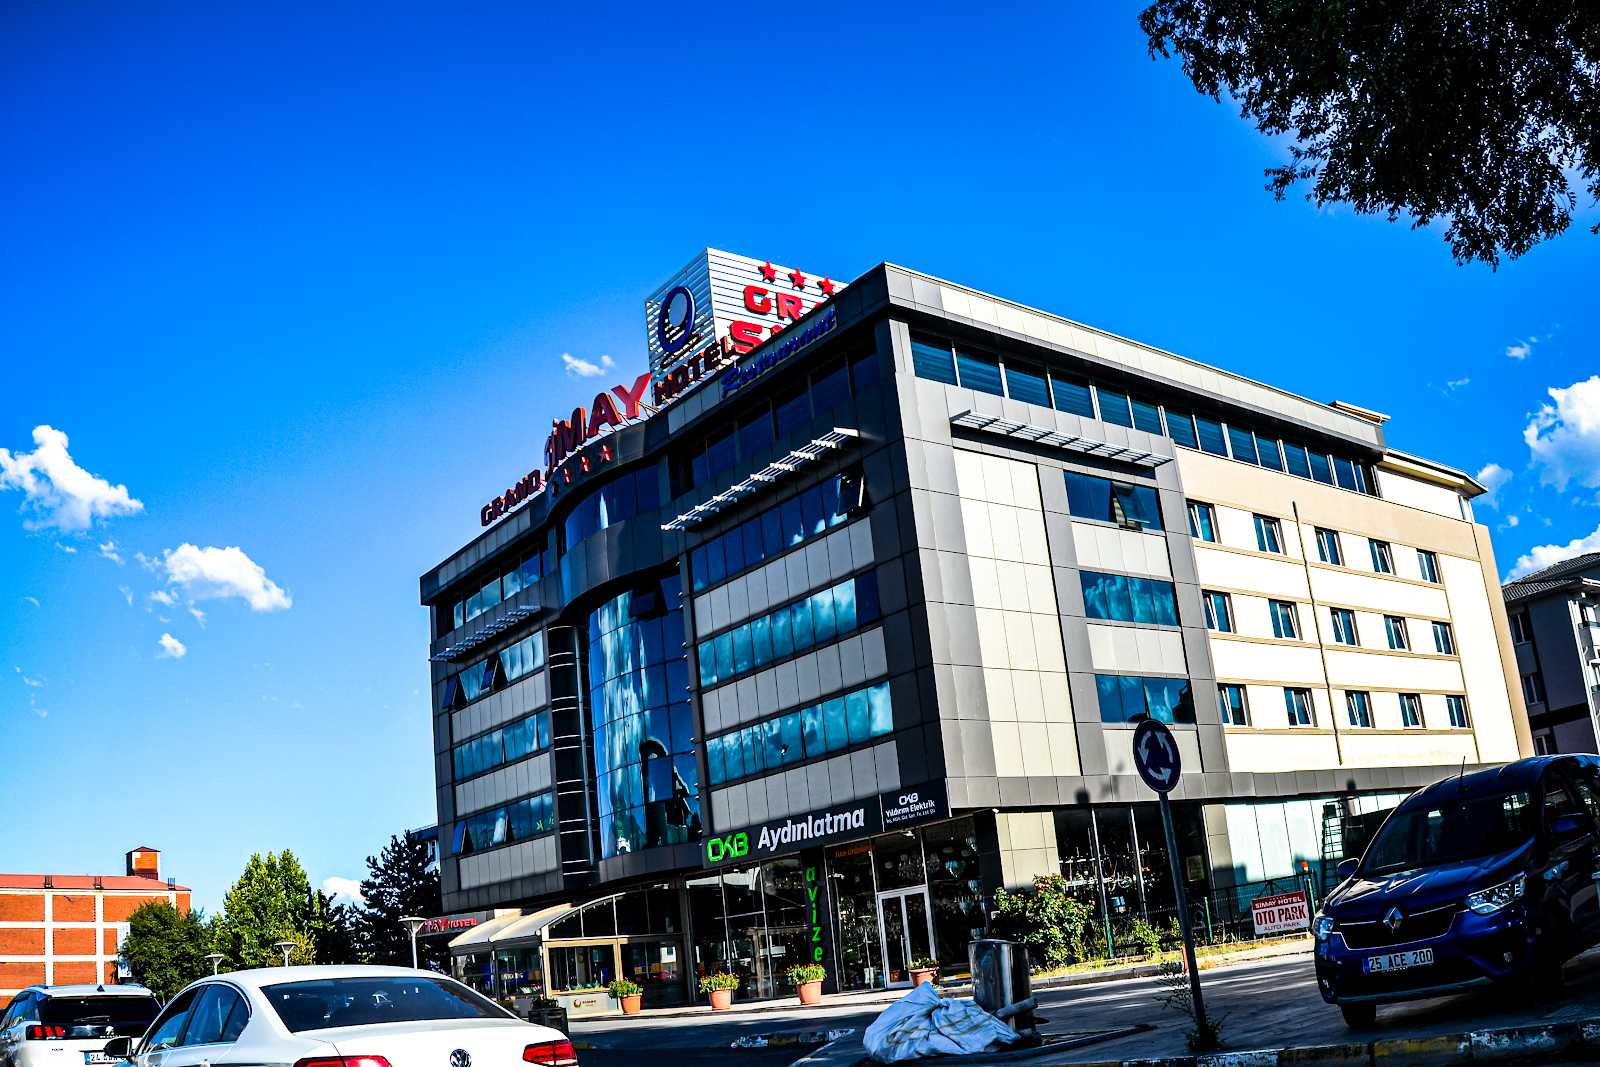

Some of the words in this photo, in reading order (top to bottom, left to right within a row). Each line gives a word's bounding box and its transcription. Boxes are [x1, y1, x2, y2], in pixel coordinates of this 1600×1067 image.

[743, 284, 826, 321] GR
[721, 308, 837, 399] Restaurant
[480, 469, 541, 527] GRAND
[653, 336, 738, 405] HOTEL
[706, 832, 749, 862] OKB
[757, 807, 865, 851] Aydınlatma
[806, 866, 823, 962] avize
[1255, 910, 1276, 926] OTO
[1278, 905, 1307, 923] PARK
[1278, 896, 1303, 905] HOTEL
[1369, 957, 1383, 970] 25
[1388, 953, 1408, 968] ACE
[1412, 949, 1433, 964] 200
